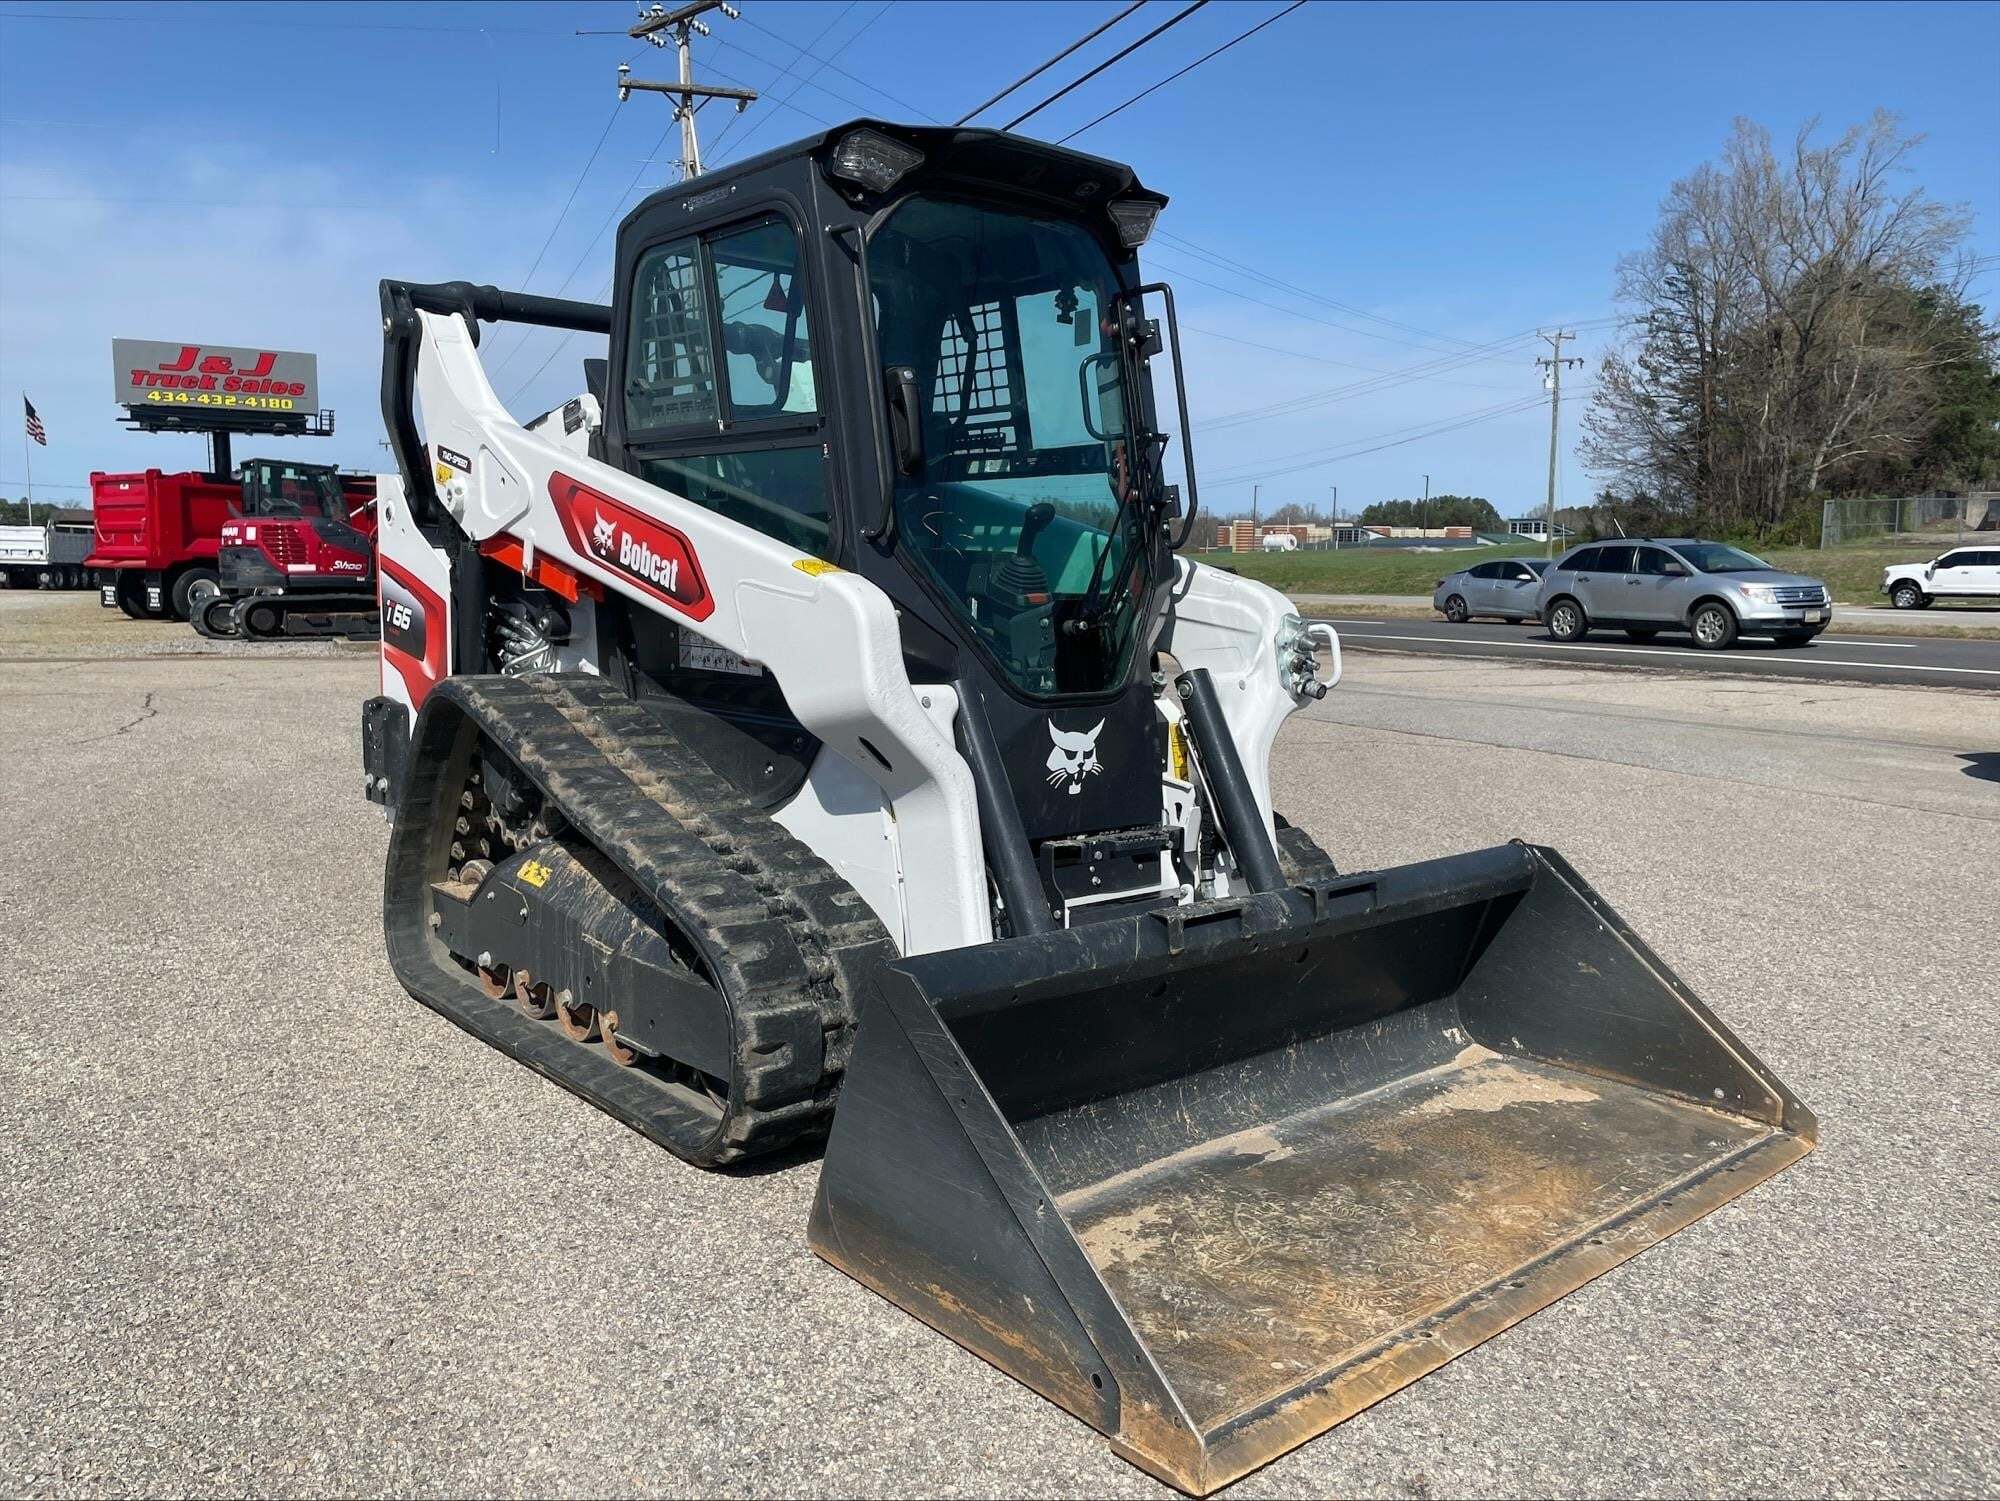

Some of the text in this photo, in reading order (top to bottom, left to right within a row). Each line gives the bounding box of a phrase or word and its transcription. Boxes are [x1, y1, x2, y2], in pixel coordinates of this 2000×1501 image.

[131, 369, 306, 396] Truck Sales
[147, 390, 293, 409] 434-432-4180
[619, 530, 678, 593] Bobcat
[386, 599, 412, 631] T66
